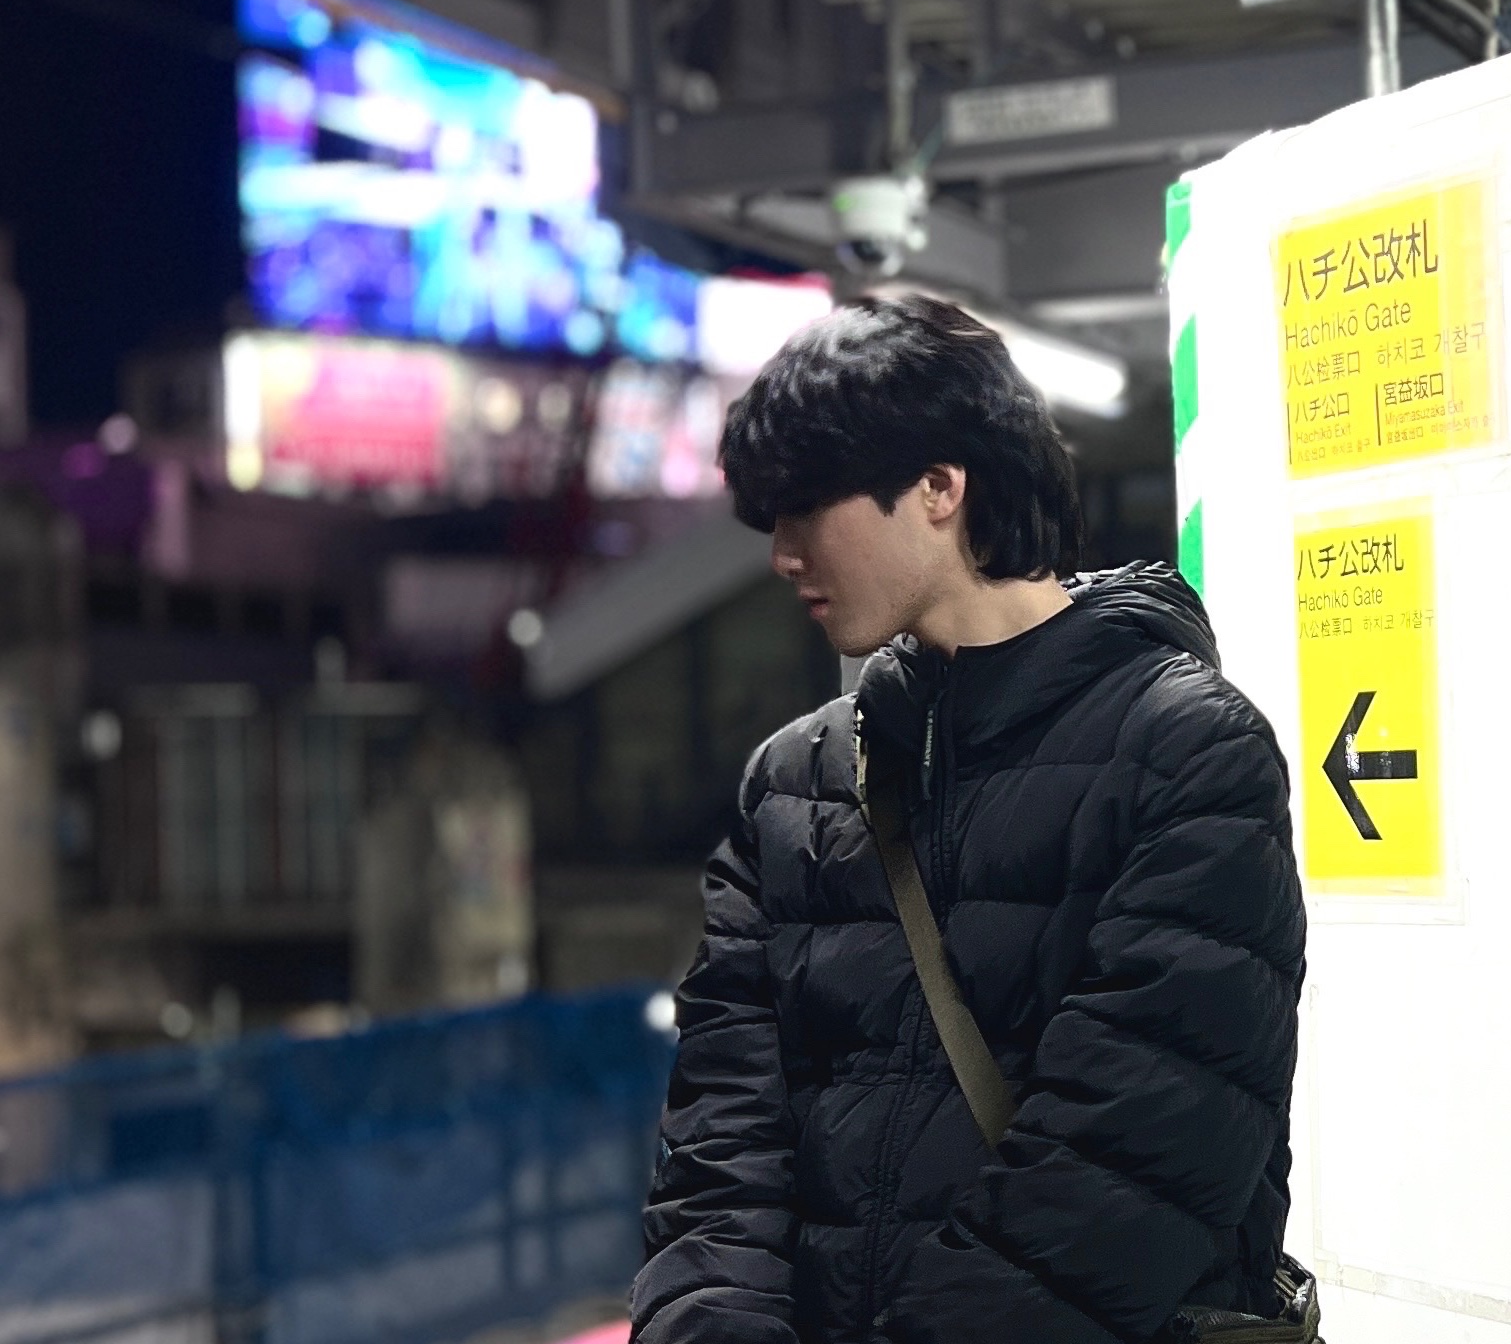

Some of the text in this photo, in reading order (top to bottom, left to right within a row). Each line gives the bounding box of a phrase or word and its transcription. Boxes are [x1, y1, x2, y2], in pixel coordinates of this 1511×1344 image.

[1284, 219, 1438, 306] ハチ公改札
[1365, 299, 1412, 331] Gate
[1377, 337, 1426, 368] 하치코
[1295, 392, 1349, 424] ハチ公口
[1297, 533, 1404, 581] ハチ公改札
[1353, 586, 1383, 606] Gate
